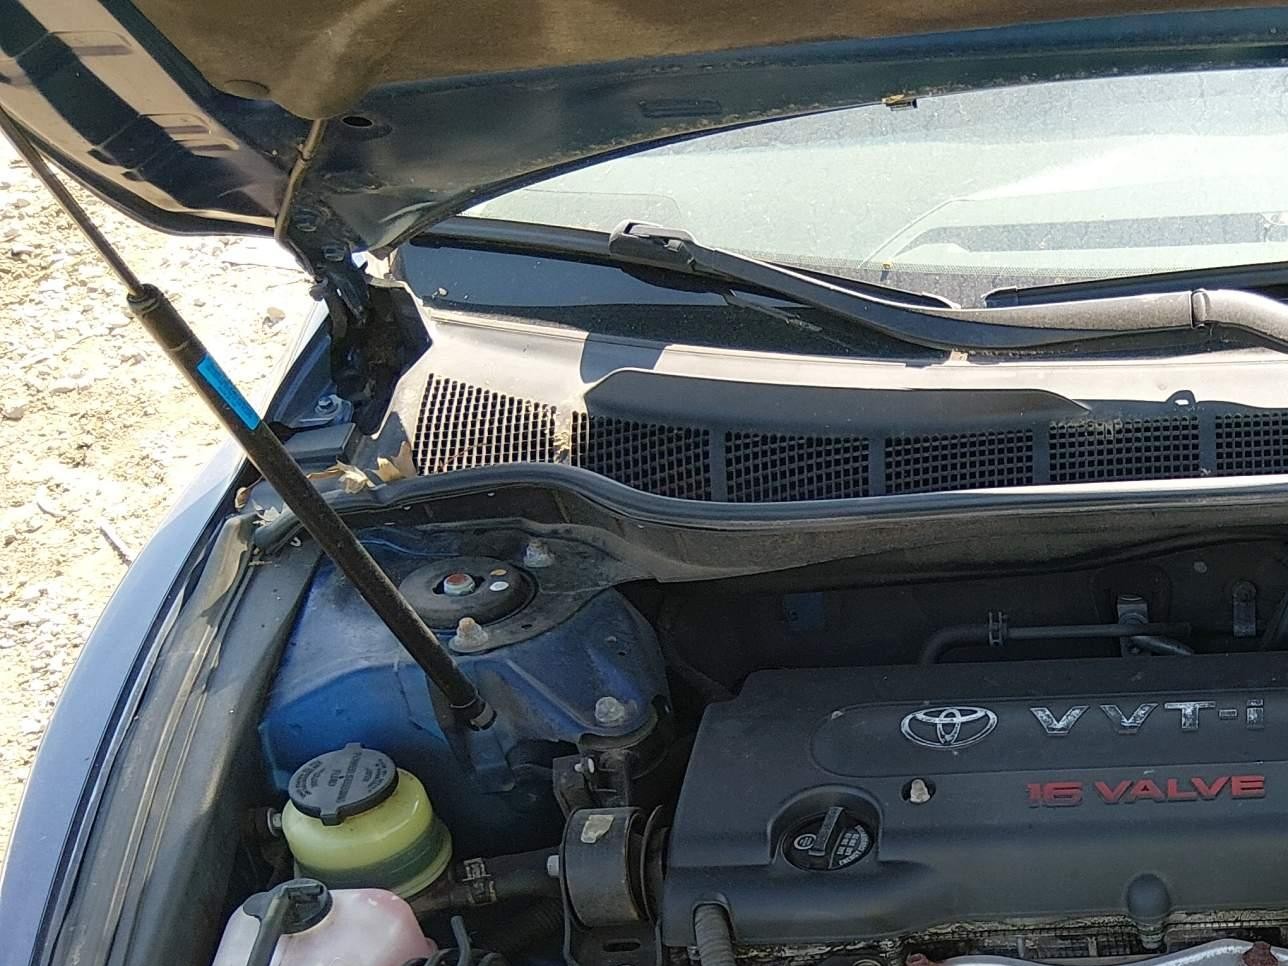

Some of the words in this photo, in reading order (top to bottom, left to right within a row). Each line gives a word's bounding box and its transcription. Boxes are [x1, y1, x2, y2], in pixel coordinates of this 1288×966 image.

[1029, 699, 1265, 735] VVT-i
[1026, 781, 1083, 807] 16
[1094, 775, 1266, 804] VALVE
